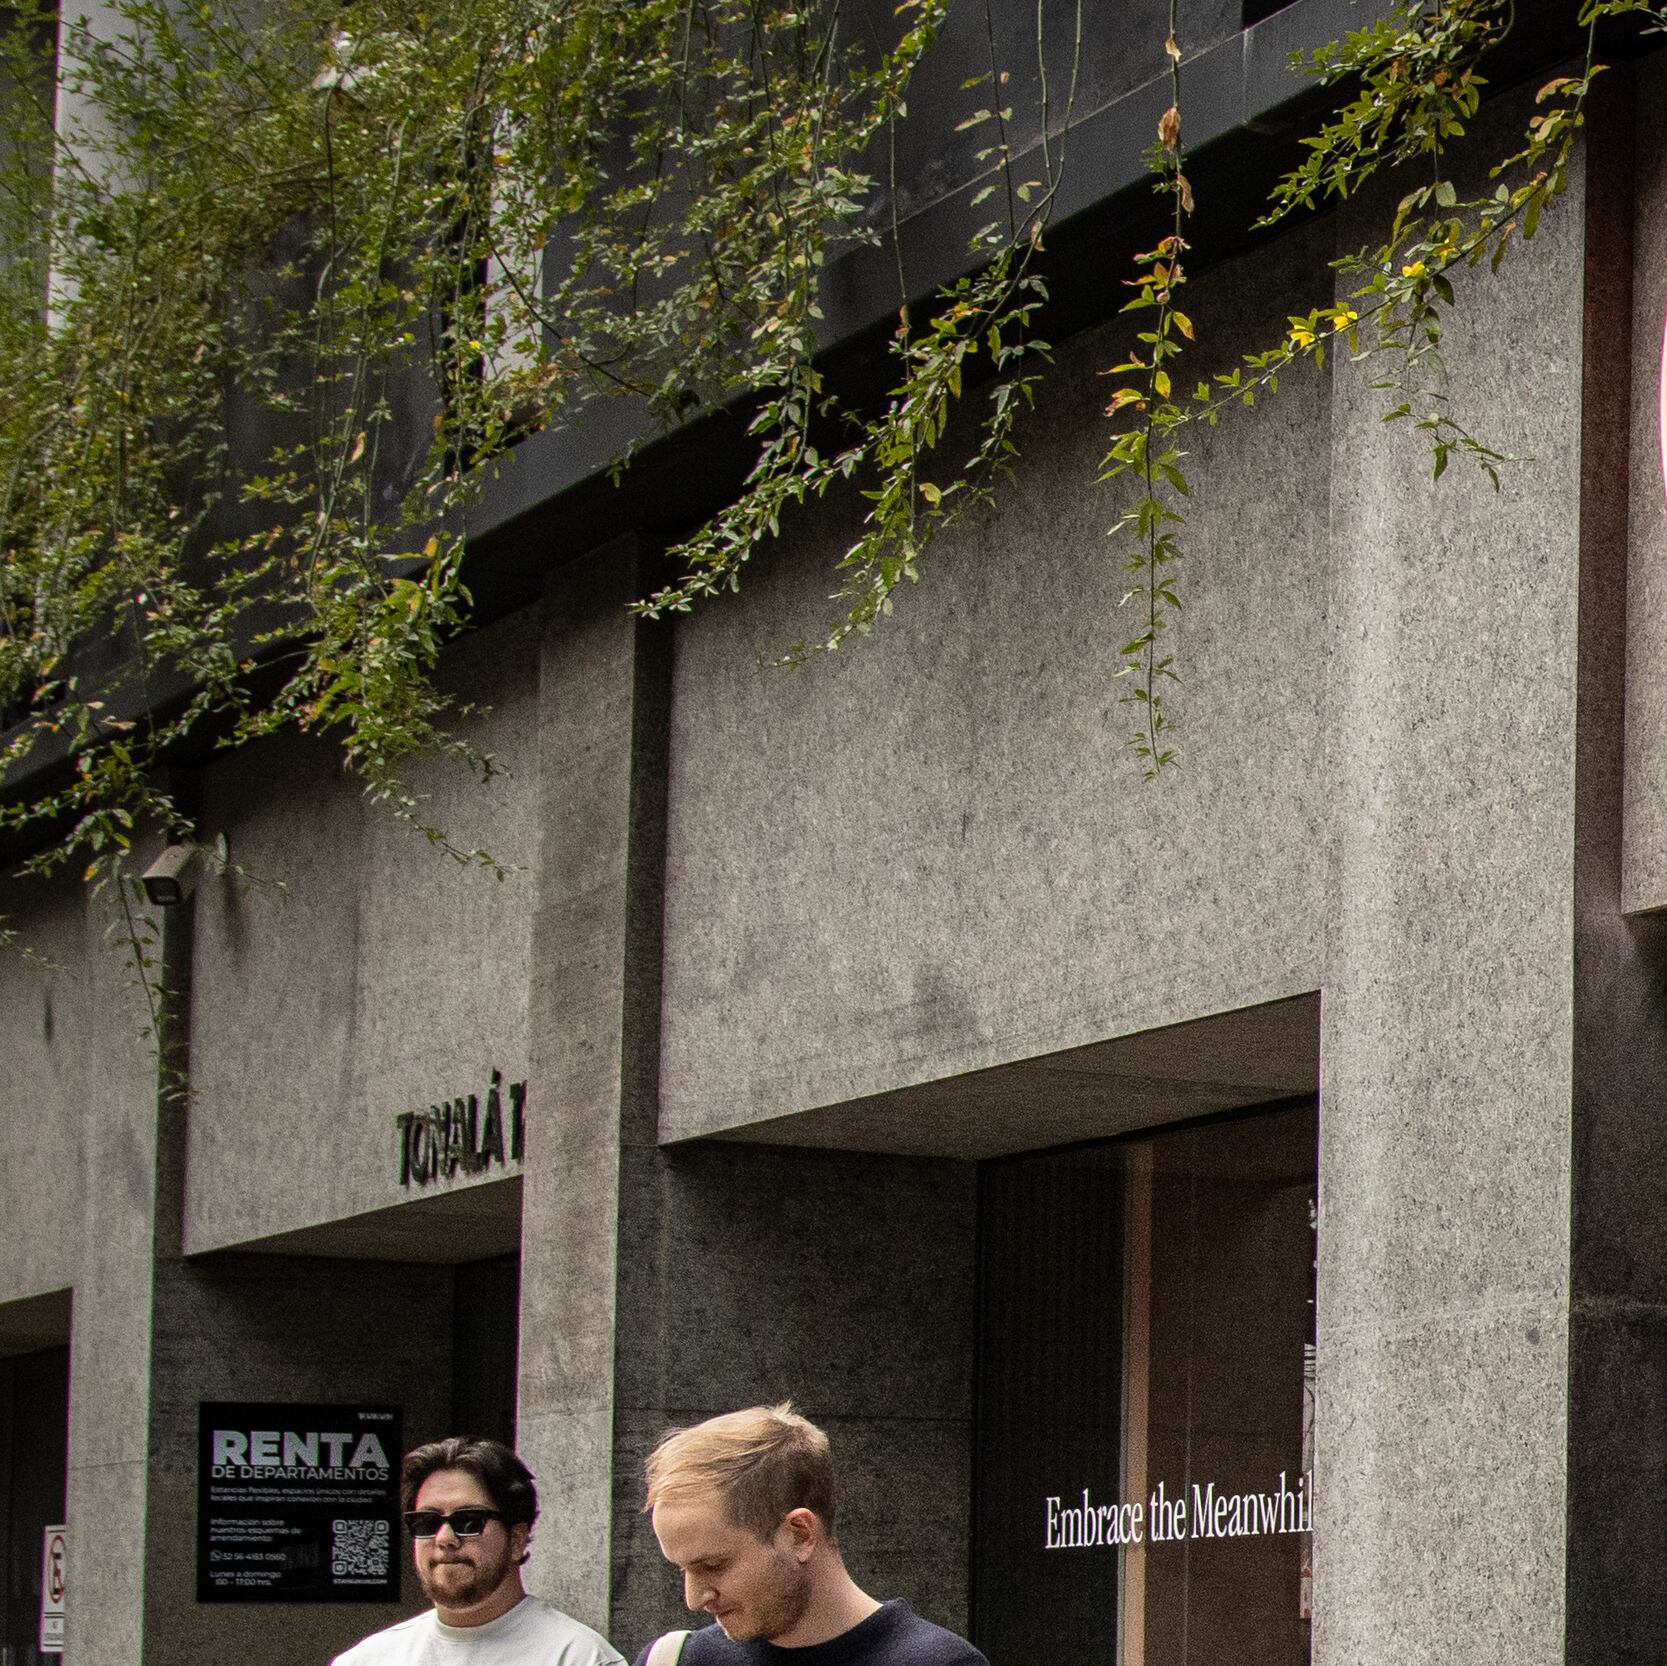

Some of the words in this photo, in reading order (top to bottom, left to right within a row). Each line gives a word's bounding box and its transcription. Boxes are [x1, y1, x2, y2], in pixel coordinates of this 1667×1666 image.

[397, 1067, 504, 1188] TONALÁ
[211, 1429, 391, 1468] RENTA
[211, 1466, 237, 1479] DE
[240, 1466, 389, 1482] DEPARTAMENTOS
[1045, 1487, 1144, 1551] Embrace
[1149, 1480, 1186, 1541] the
[1191, 1469, 1314, 1540] Meanwhil
